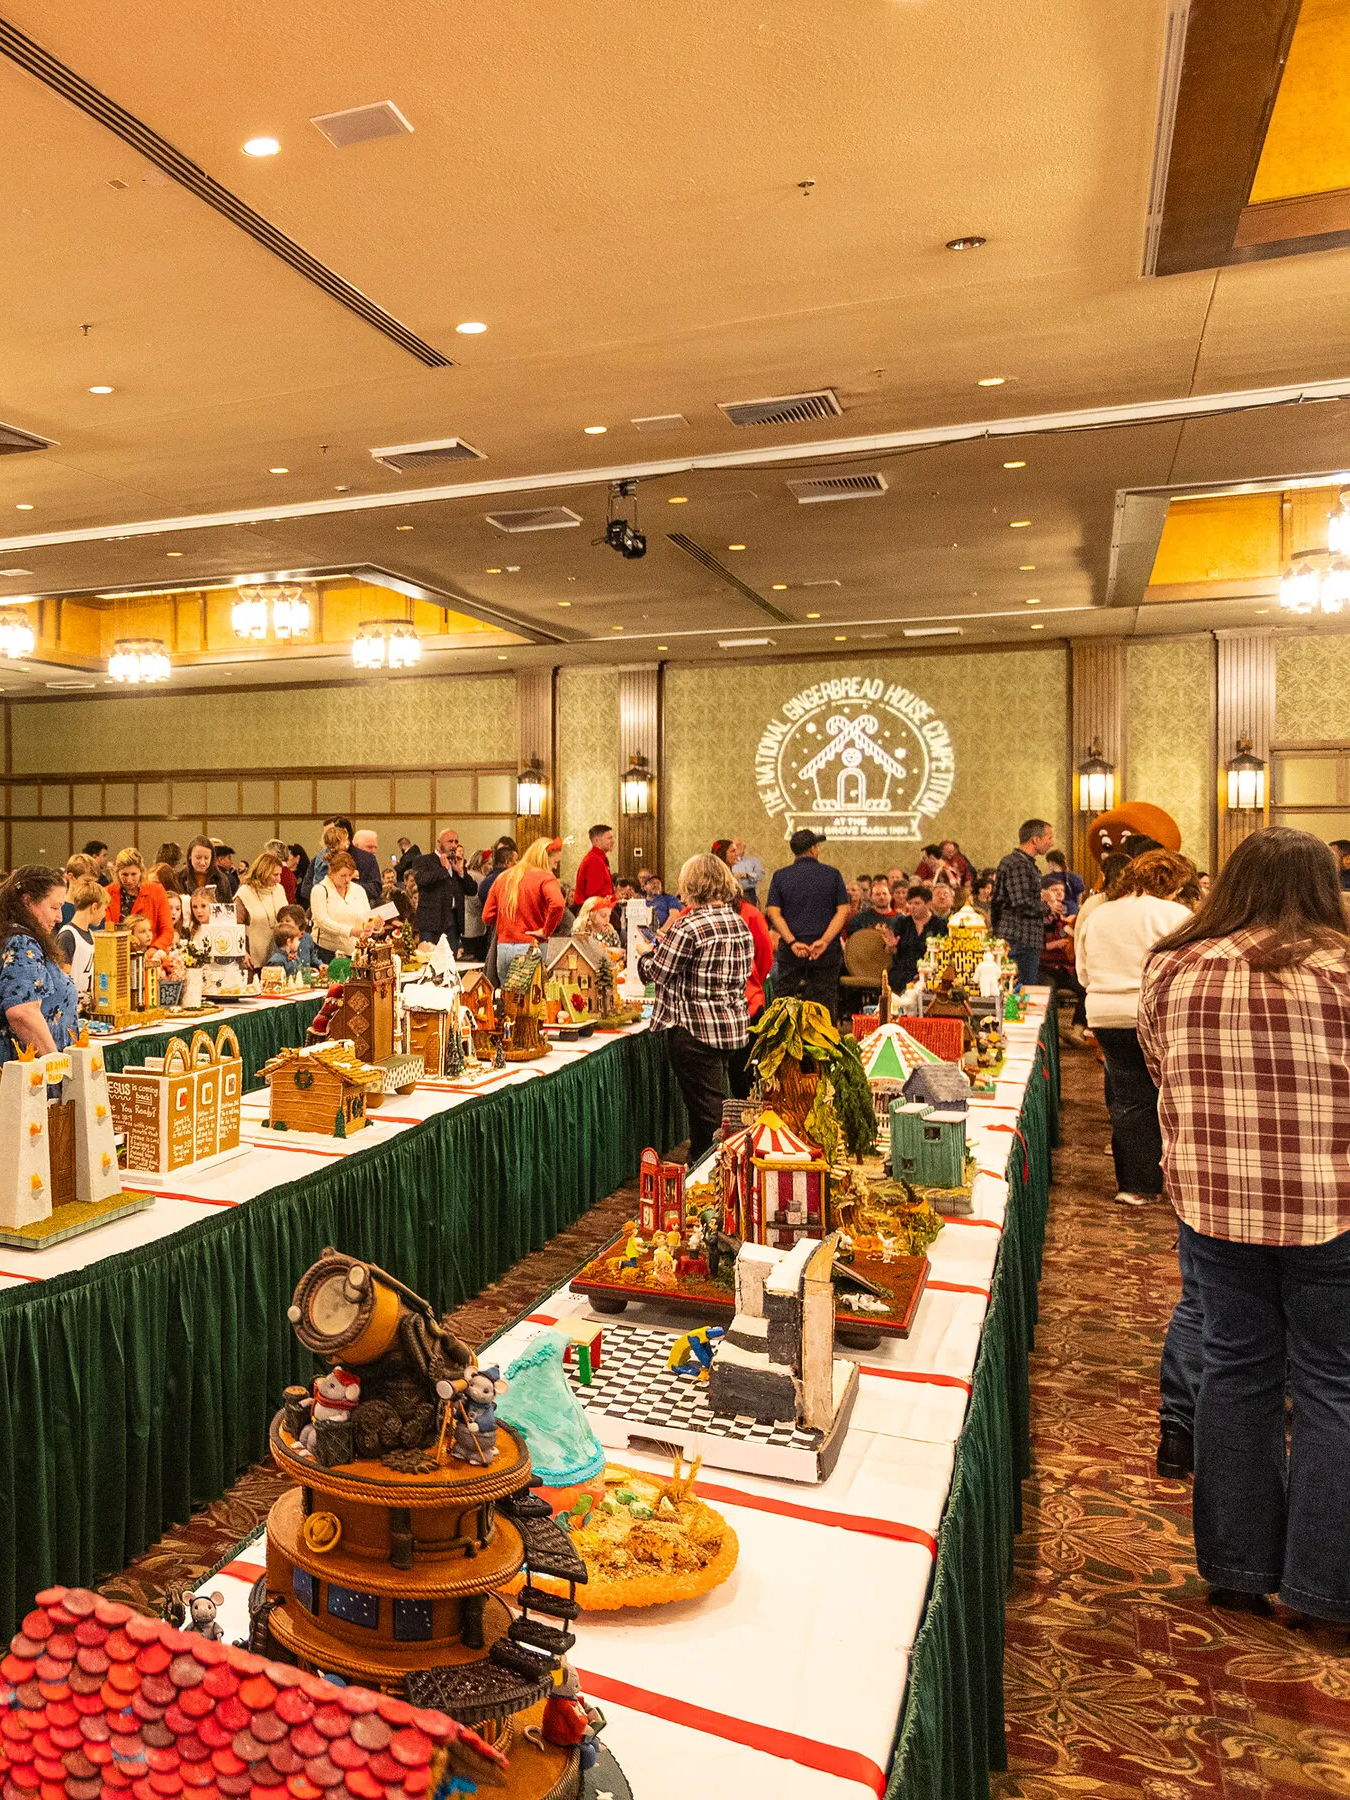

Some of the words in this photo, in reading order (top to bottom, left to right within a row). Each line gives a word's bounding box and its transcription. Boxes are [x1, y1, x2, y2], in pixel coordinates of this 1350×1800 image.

[782, 676, 884, 720] GINGERBREAD
[884, 683, 935, 725] HOUSE
[755, 718, 792, 786] NATIONAL
[916, 720, 955, 818] COMPETITION
[759, 786, 786, 818] THE
[824, 826, 859, 836] GROVE
[861, 826, 887, 836] PARK
[833, 817, 845, 826] AT
[847, 817, 868, 826] THE
[108, 1081, 131, 1095] ESUS
[138, 1085, 158, 1097] coming
[120, 1103, 132, 1113] You
[135, 1104, 157, 1117] Ready?
